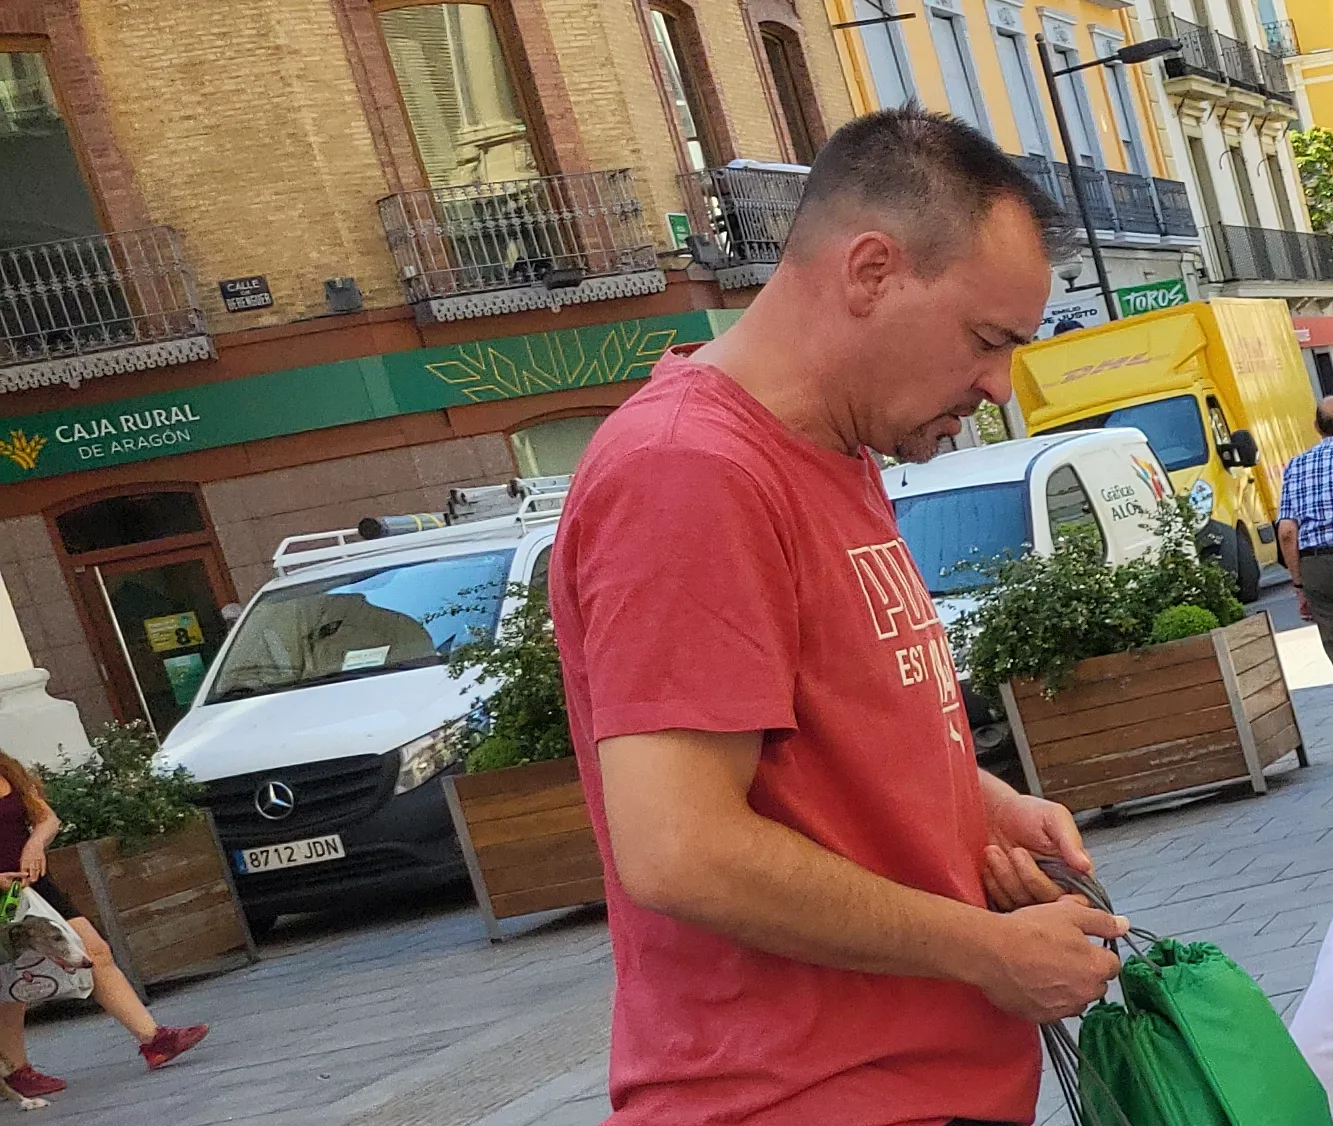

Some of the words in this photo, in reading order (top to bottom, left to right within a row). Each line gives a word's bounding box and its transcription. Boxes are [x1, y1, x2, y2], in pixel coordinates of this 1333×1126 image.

[227, 280, 261, 292] CALLE
[1123, 284, 1184, 313] TOROS
[1051, 305, 1082, 316] EMILIO
[1057, 308, 1098, 322] JUSTO
[1061, 352, 1152, 384] DHL
[55, 419, 118, 443] CAJA
[119, 404, 200, 432] RURAL
[78, 443, 105, 460] DE
[111, 429, 191, 454] ARAGÓN
[249, 846, 297, 868] 8712
[304, 838, 340, 859] JDN
